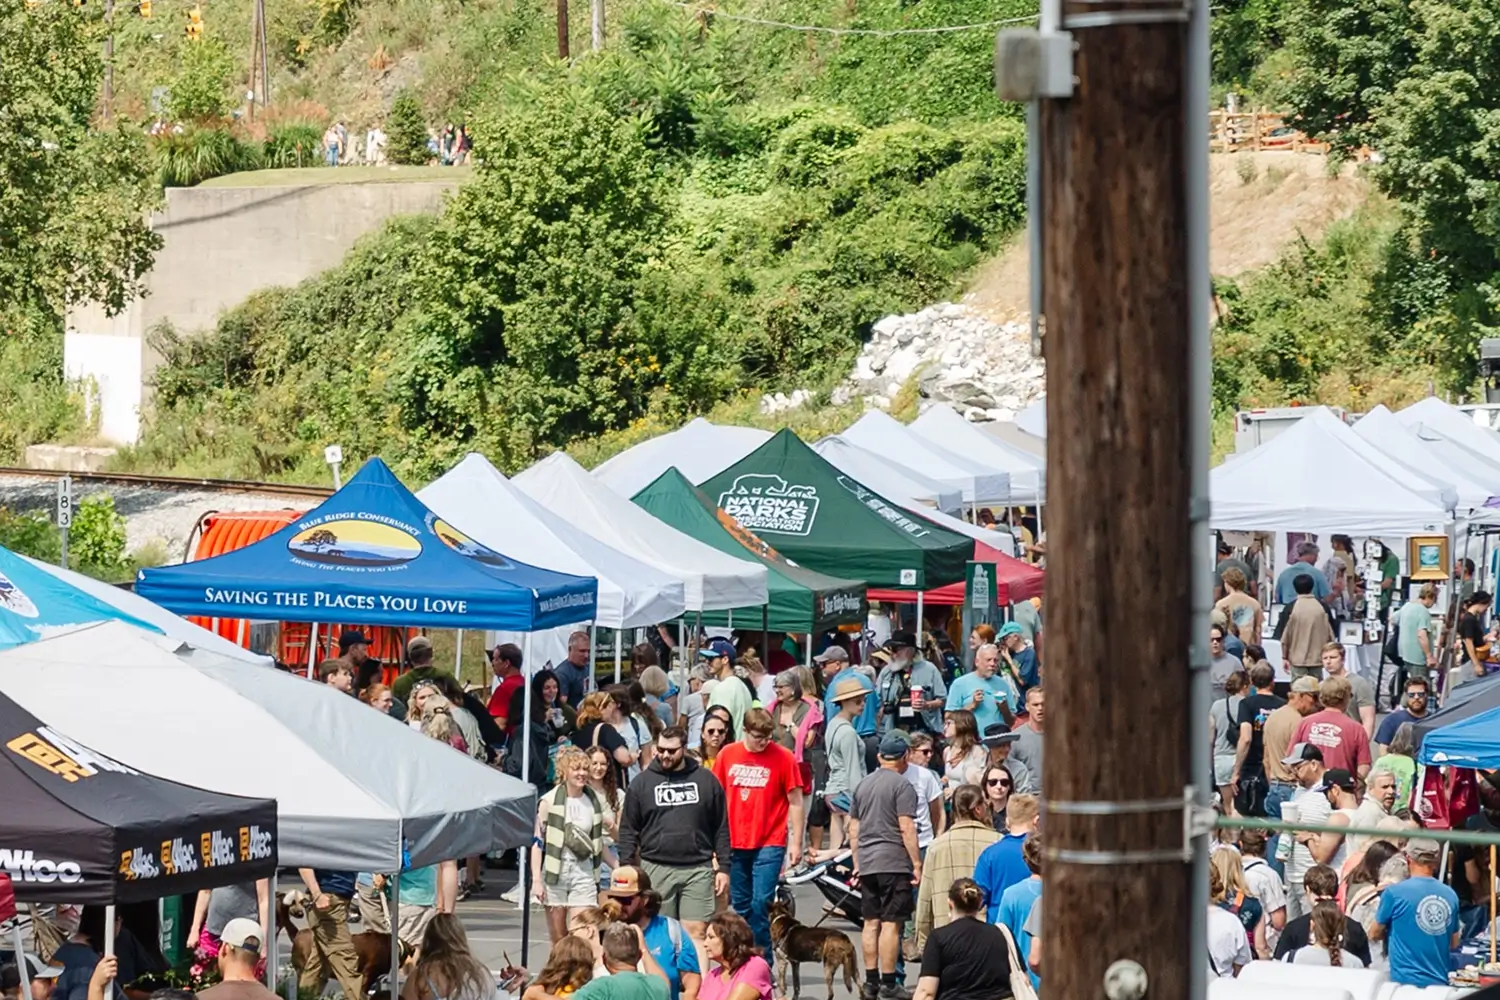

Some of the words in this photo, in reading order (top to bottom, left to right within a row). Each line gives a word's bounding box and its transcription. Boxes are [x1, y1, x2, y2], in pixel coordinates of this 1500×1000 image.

[724, 505, 809, 520] PARKS
[727, 496, 809, 511] NATIONAL
[299, 518, 323, 531] BLUE
[325, 512, 356, 522] RIDGE
[357, 511, 422, 536] CONSERVANCY
[205, 587, 268, 605] SAVING
[273, 592, 308, 607] THE
[314, 591, 375, 610] PLACES
[380, 595, 418, 611] YOU
[423, 597, 467, 613] LOVE
[211, 829, 235, 866] Altec
[249, 825, 273, 861] Altec
